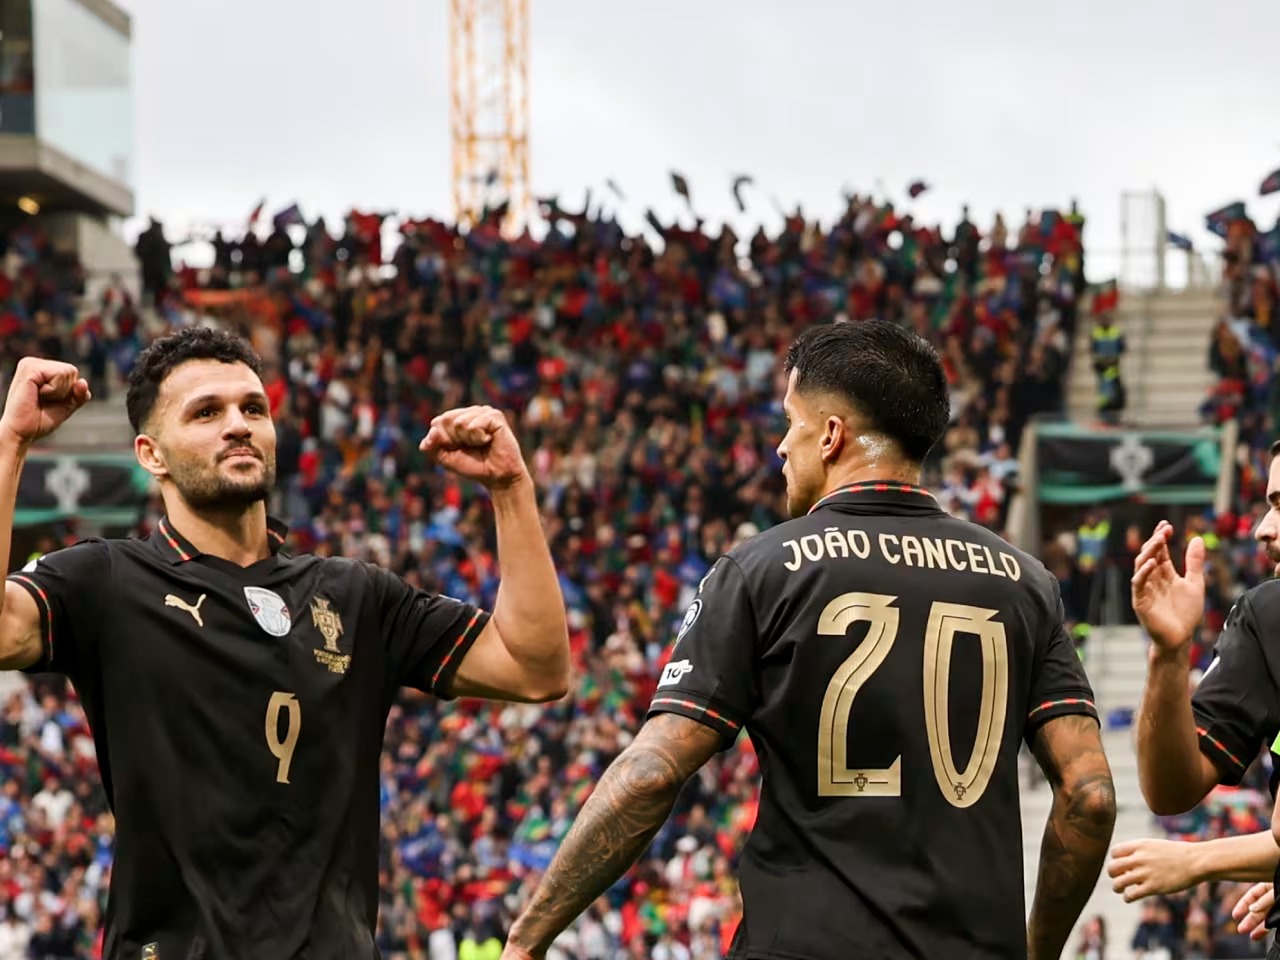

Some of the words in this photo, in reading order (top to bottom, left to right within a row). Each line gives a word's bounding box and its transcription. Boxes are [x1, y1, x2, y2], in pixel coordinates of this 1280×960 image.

[782, 526, 870, 572] JOÃO
[878, 533, 1021, 582] CANCELO
[265, 691, 301, 784] 9
[817, 592, 1008, 808] 20
